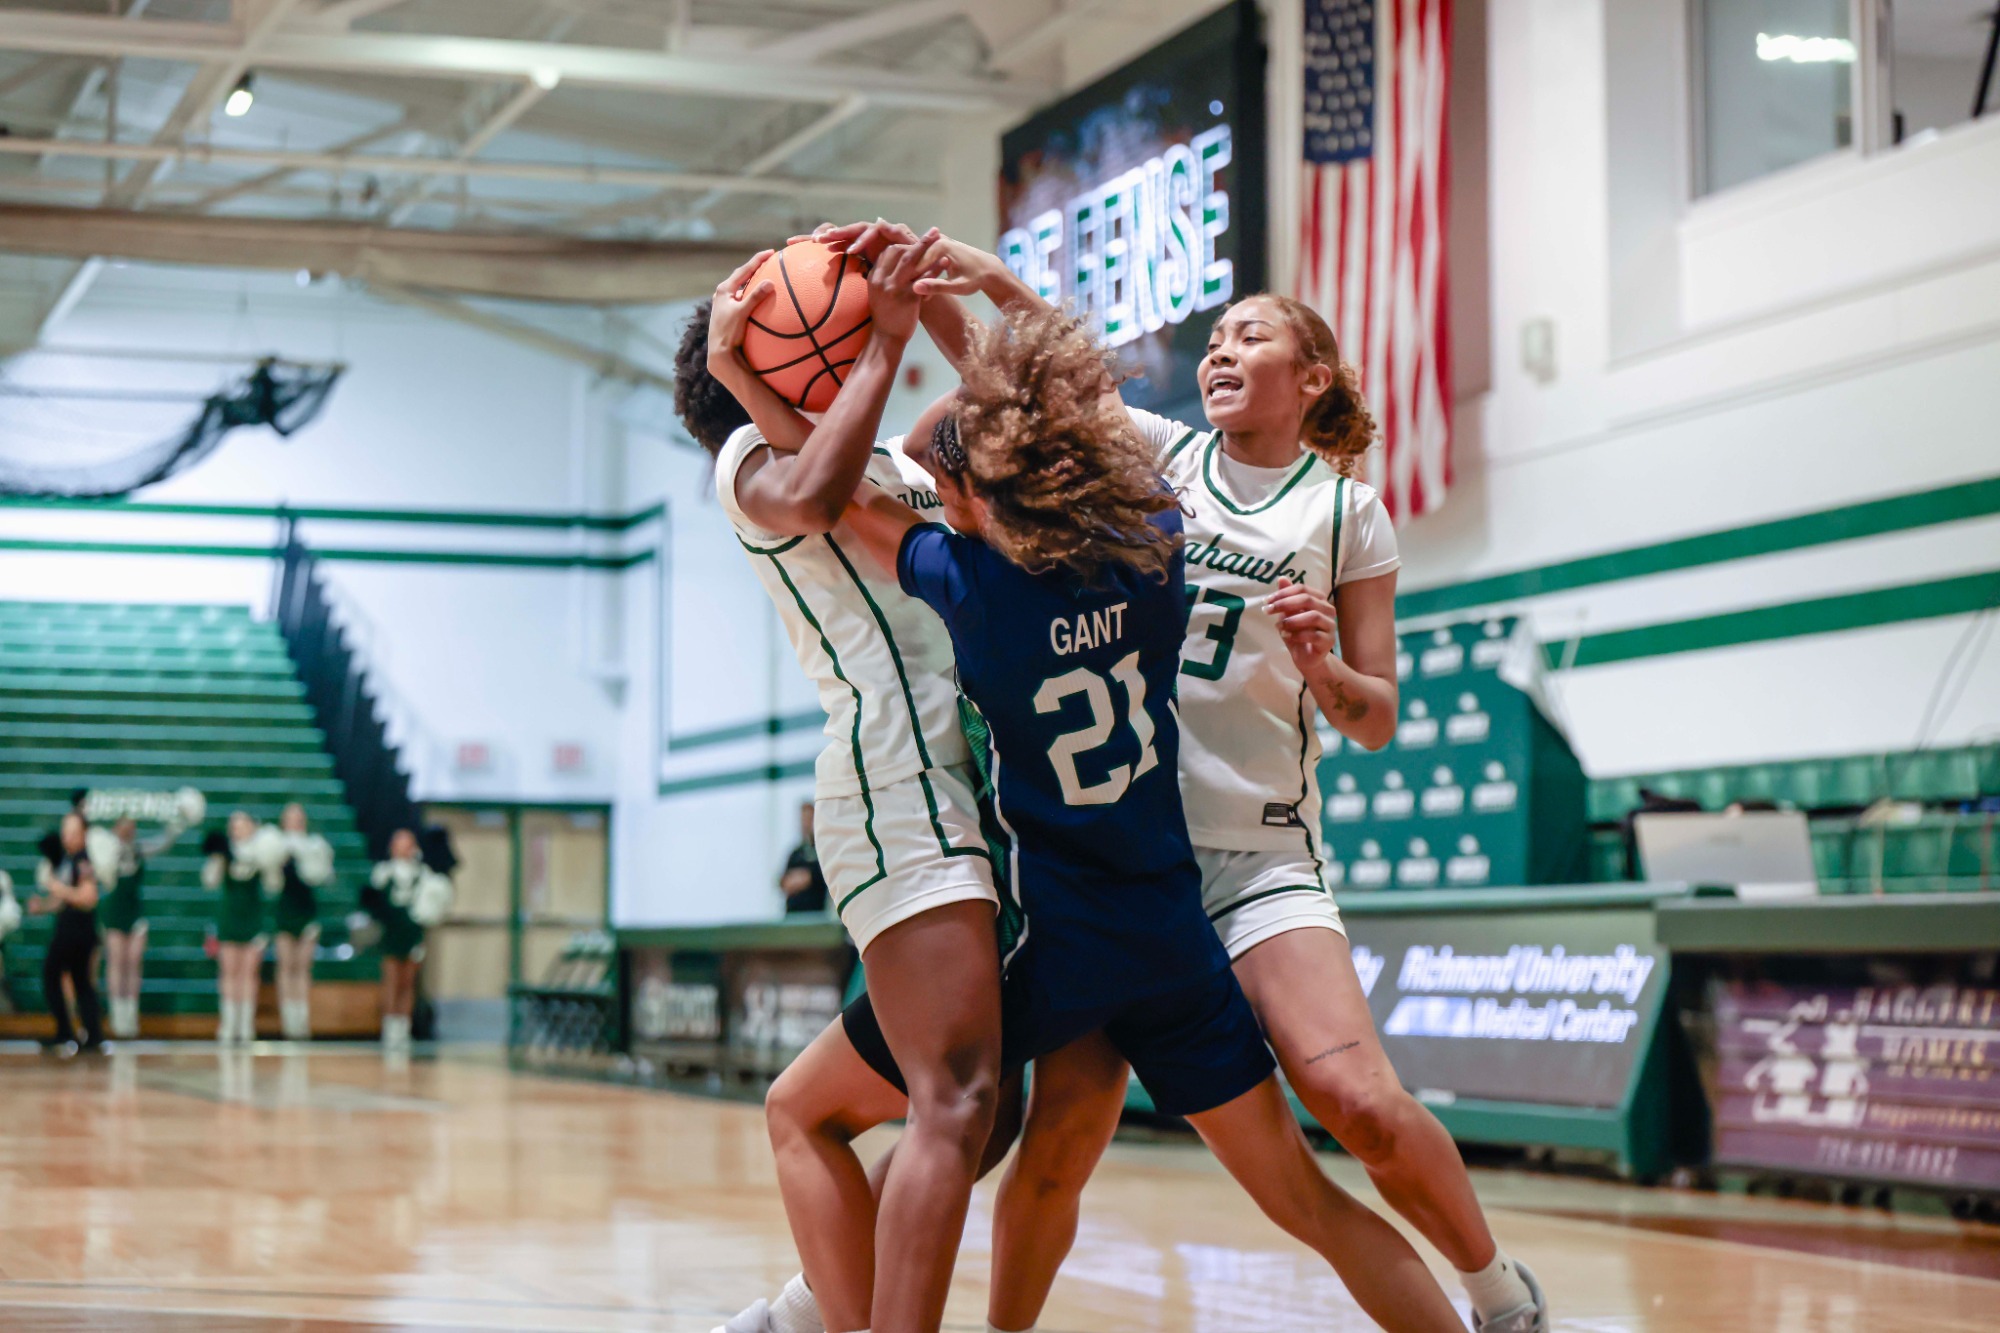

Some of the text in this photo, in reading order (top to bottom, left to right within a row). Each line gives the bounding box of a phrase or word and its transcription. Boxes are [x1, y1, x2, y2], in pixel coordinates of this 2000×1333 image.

[1050, 602, 1127, 656] GANT
[1033, 650, 1159, 806] 21
[1397, 943, 1655, 1004] Richmond University
[1472, 997, 1638, 1042] Medical Center
